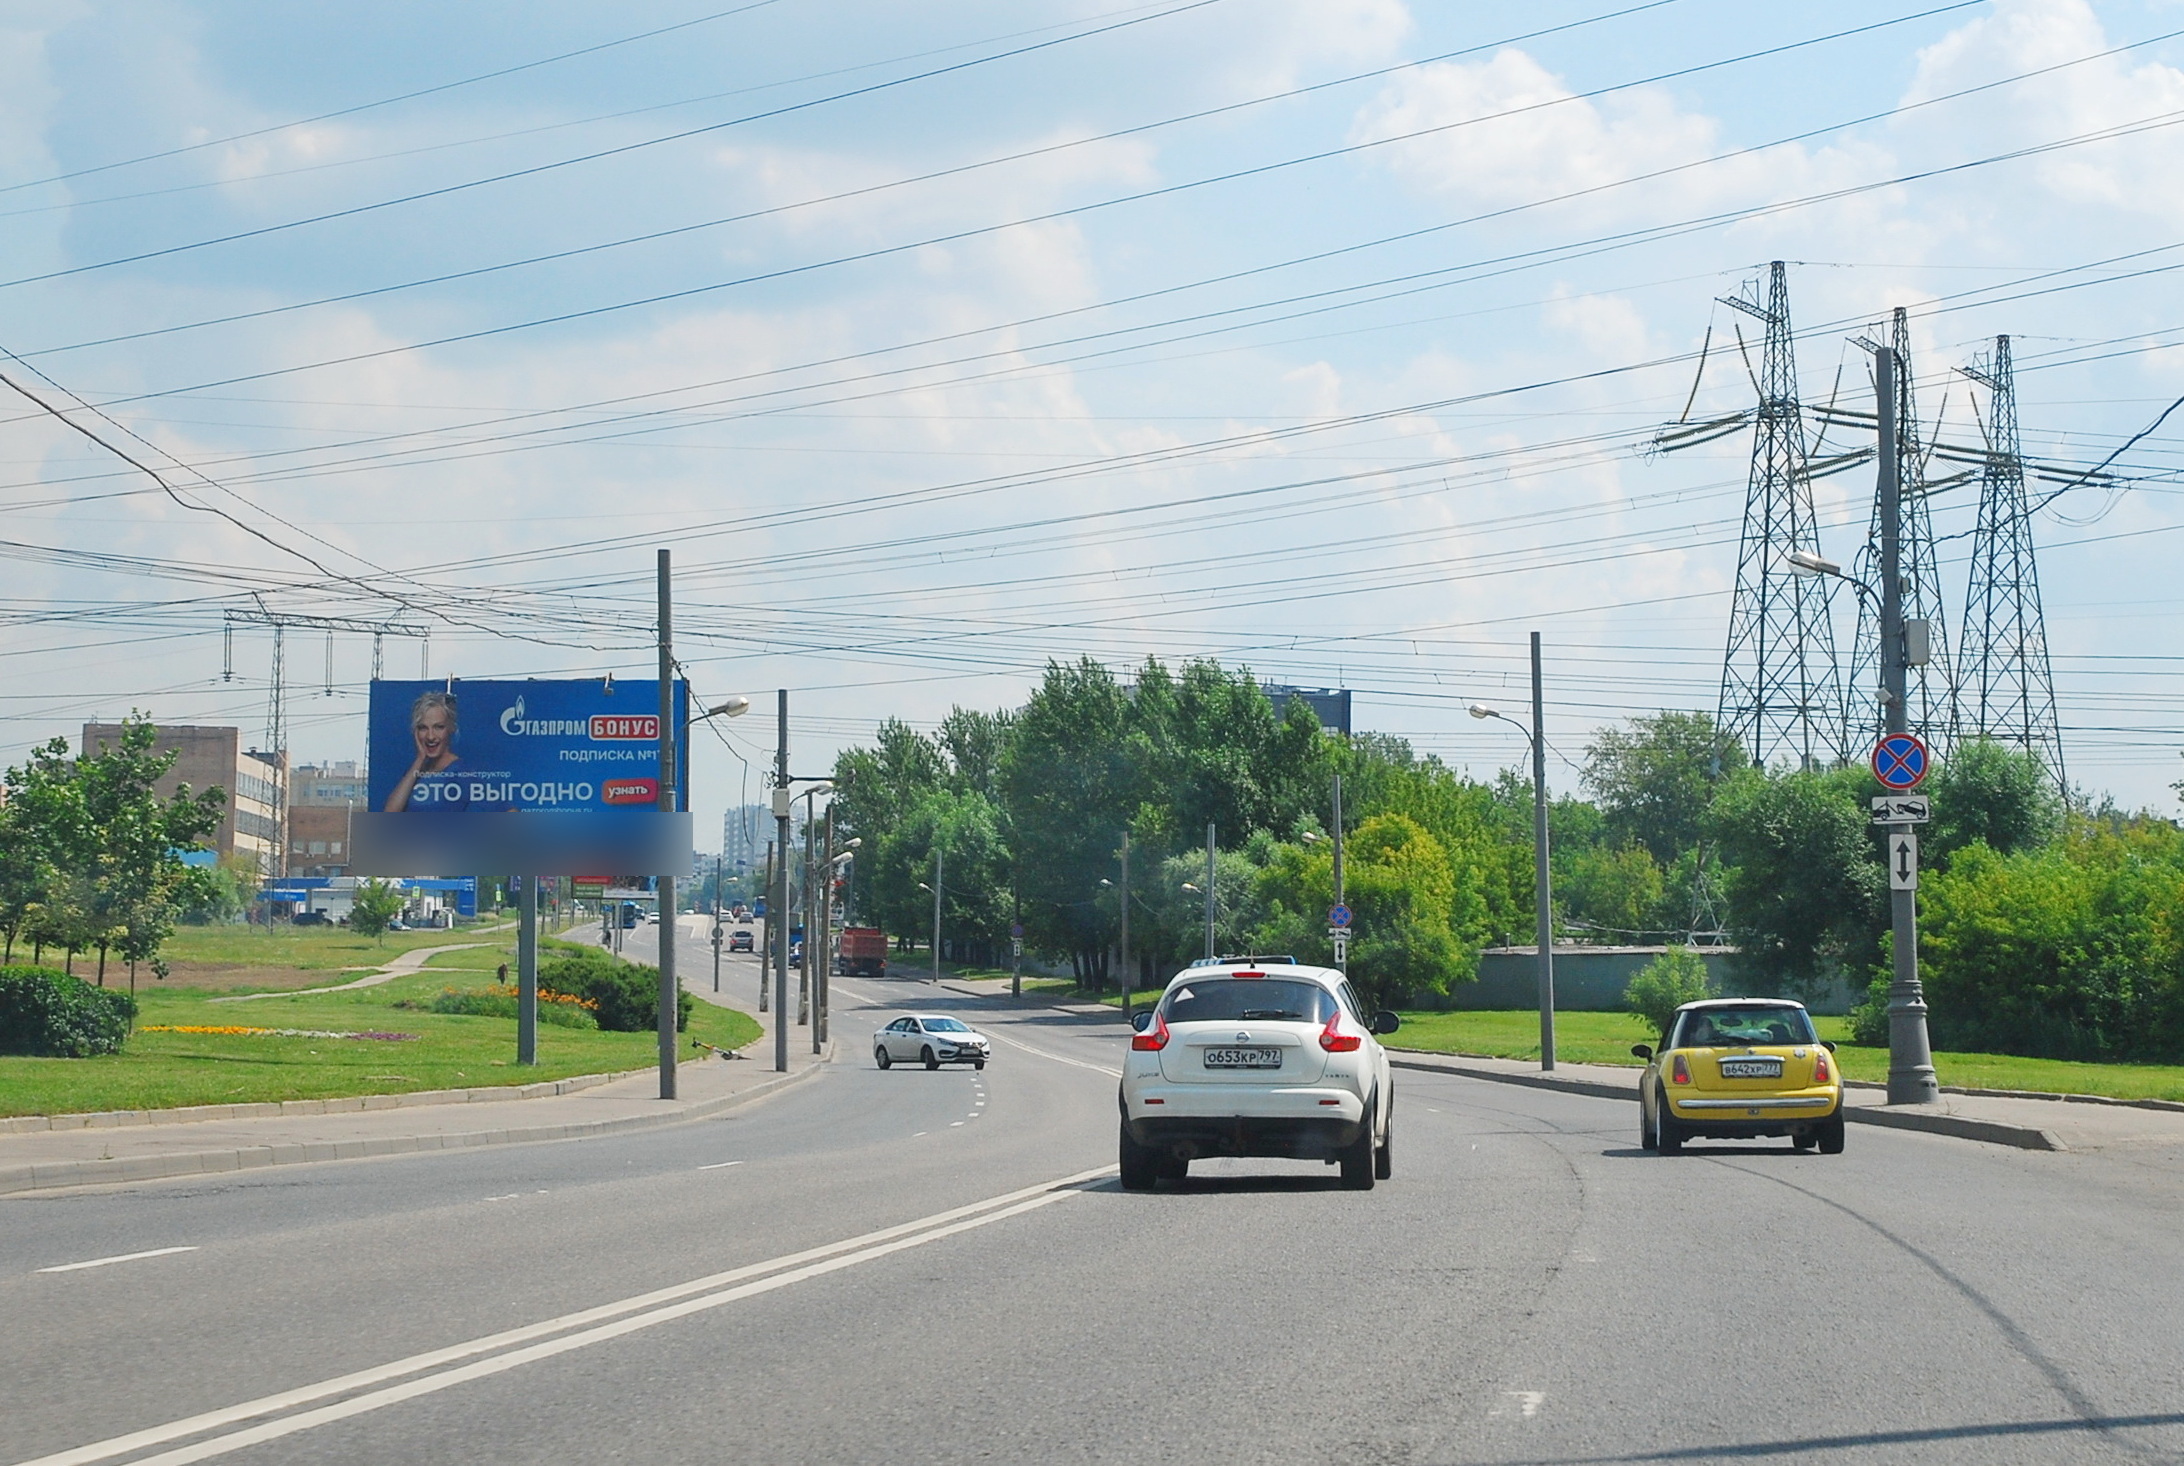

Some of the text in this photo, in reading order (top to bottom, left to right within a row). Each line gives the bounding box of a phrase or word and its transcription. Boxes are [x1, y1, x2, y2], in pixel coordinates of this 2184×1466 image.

[526, 719, 656, 736] ГАЗПРОМ БОНУС
[559, 750, 635, 763] ПОДПИСКА
[412, 769, 512, 779] Подписка-конструктор
[412, 782, 594, 805] ЭТО ВЫГОДНО
[608, 785, 649, 799] узнать
[1259, 1050, 1278, 1061] 797
